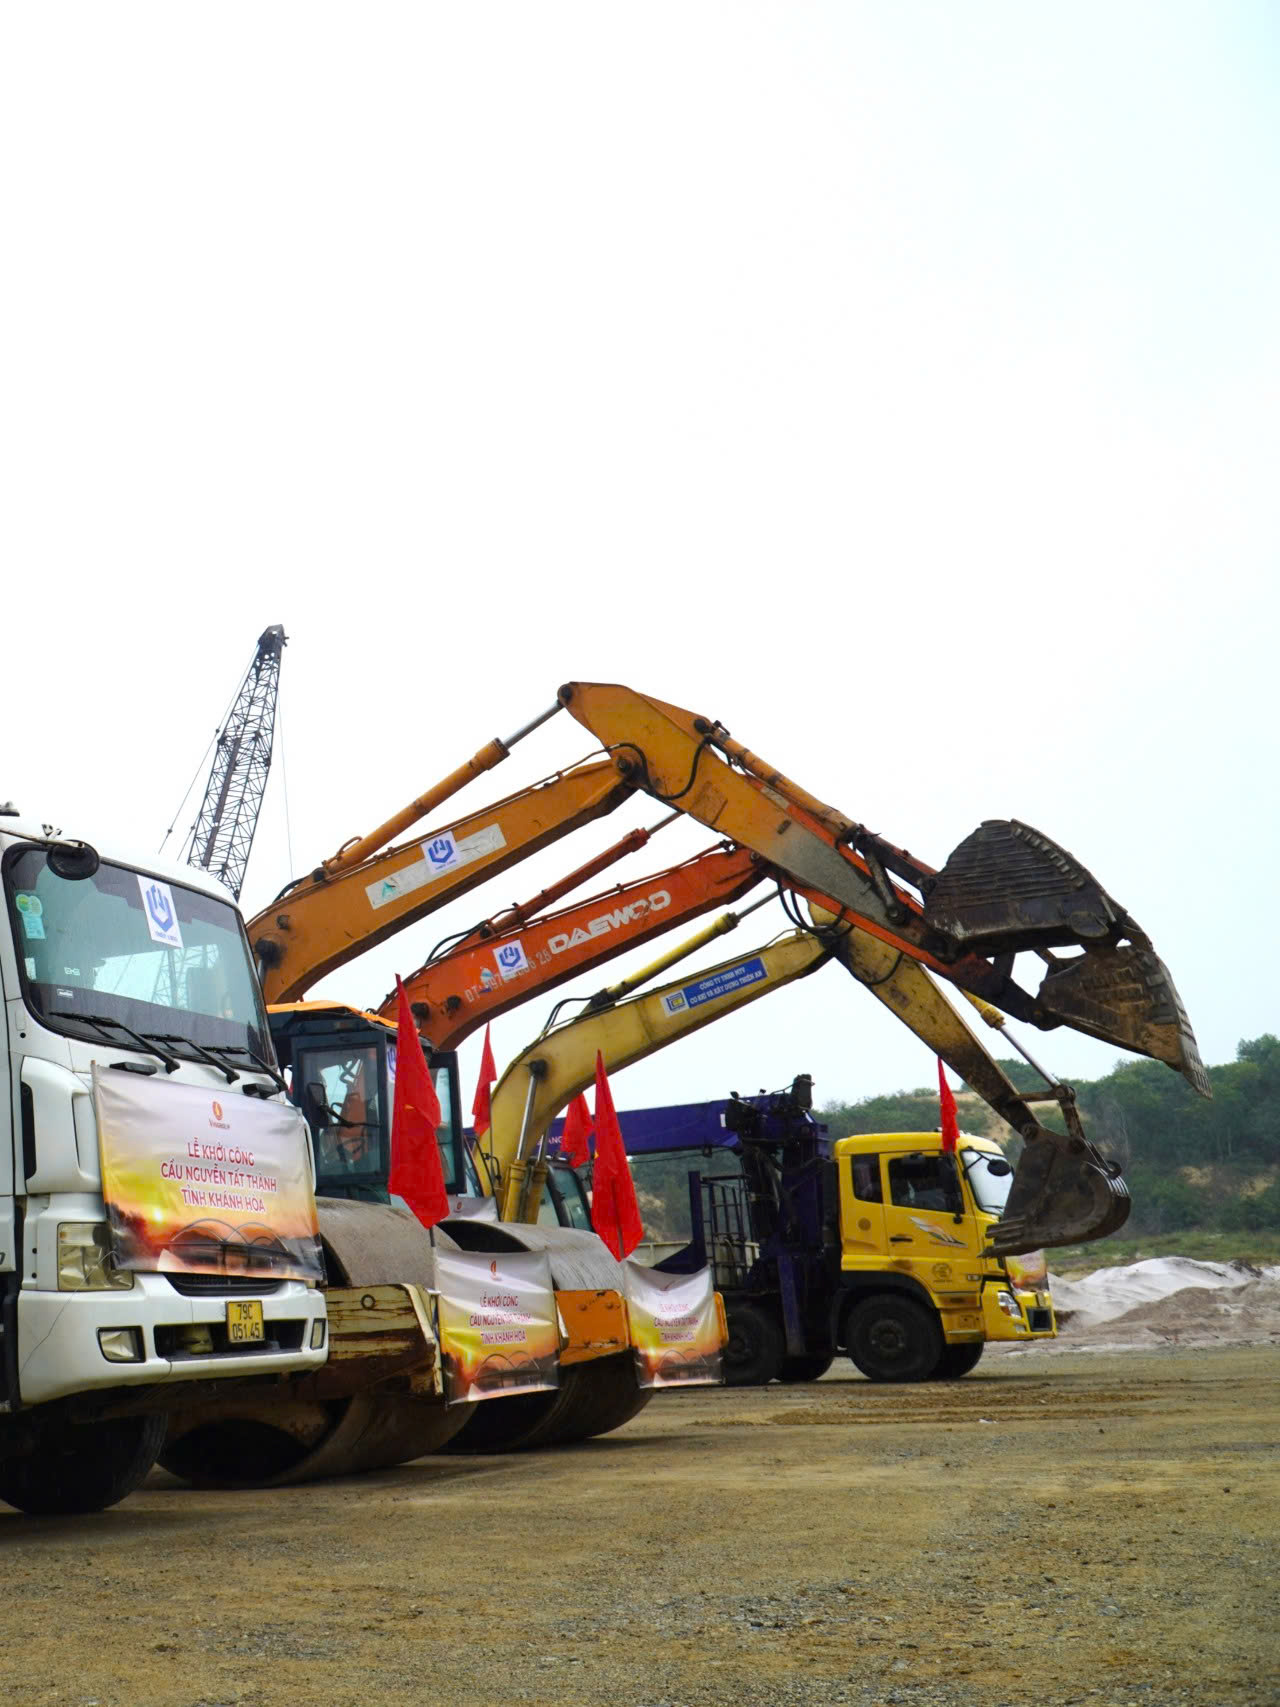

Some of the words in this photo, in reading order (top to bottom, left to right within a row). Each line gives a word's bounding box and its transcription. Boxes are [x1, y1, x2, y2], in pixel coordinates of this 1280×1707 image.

[548, 889, 671, 955] DAEWOO
[188, 1137, 200, 1158] LỄ
[202, 1142, 226, 1162] KHỞI
[229, 1147, 254, 1166] CÔNG
[186, 1163, 226, 1185] NGUYỄN
[228, 1168, 244, 1186] TẤT
[208, 1190, 242, 1209] KHÁNH
[237, 1303, 253, 1320] 79C
